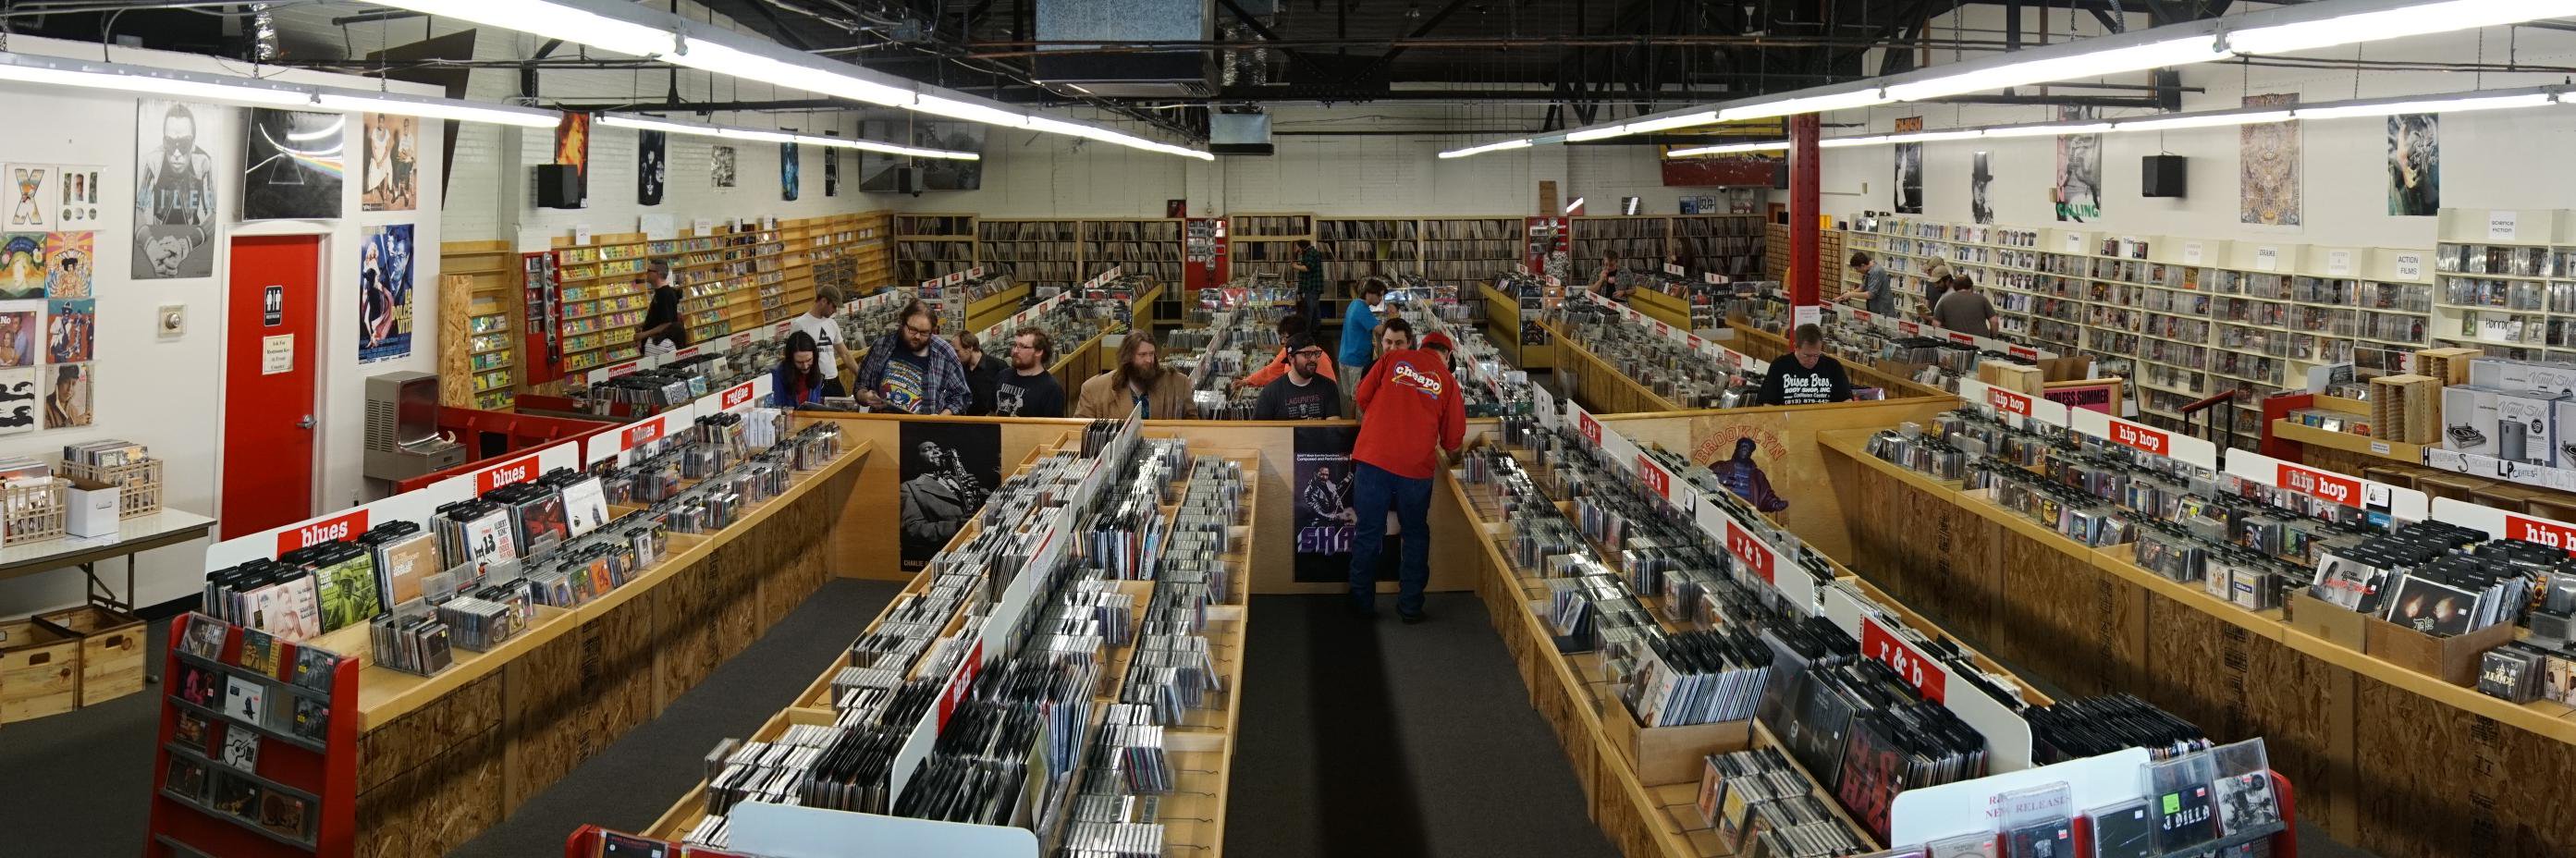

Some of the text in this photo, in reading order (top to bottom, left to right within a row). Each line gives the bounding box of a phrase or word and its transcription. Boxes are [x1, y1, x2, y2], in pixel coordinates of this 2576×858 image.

[137, 188, 216, 209] MILES
[2056, 203, 2099, 218] CALLING
[2398, 255, 2419, 264] ACTION
[2400, 266, 2418, 276] FILMS
[392, 304, 412, 321] DOLCE
[2485, 317, 2509, 331] Horror
[1395, 365, 1441, 391] cheapo
[1783, 374, 1809, 388] Brisco
[727, 386, 749, 405] reggae
[1995, 391, 2025, 413] hip hop
[2044, 388, 2109, 407] ENDLESS SUMMER
[2499, 400, 2524, 417] Vinyl
[632, 423, 656, 442] blues
[2119, 425, 2159, 450] hip hop
[1694, 425, 1786, 465] BROOKLYN
[492, 465, 525, 488] blues
[2497, 460, 2514, 479] LP
[2292, 470, 2348, 501] hip hop
[301, 521, 348, 548] blues
[482, 533, 496, 554] 13
[1297, 526, 1356, 555] SHA
[2525, 523, 2558, 548] hip
[1736, 536, 1762, 570] r & b
[1880, 641, 1922, 688] r & b
[2164, 805, 2211, 831] J DILLA
